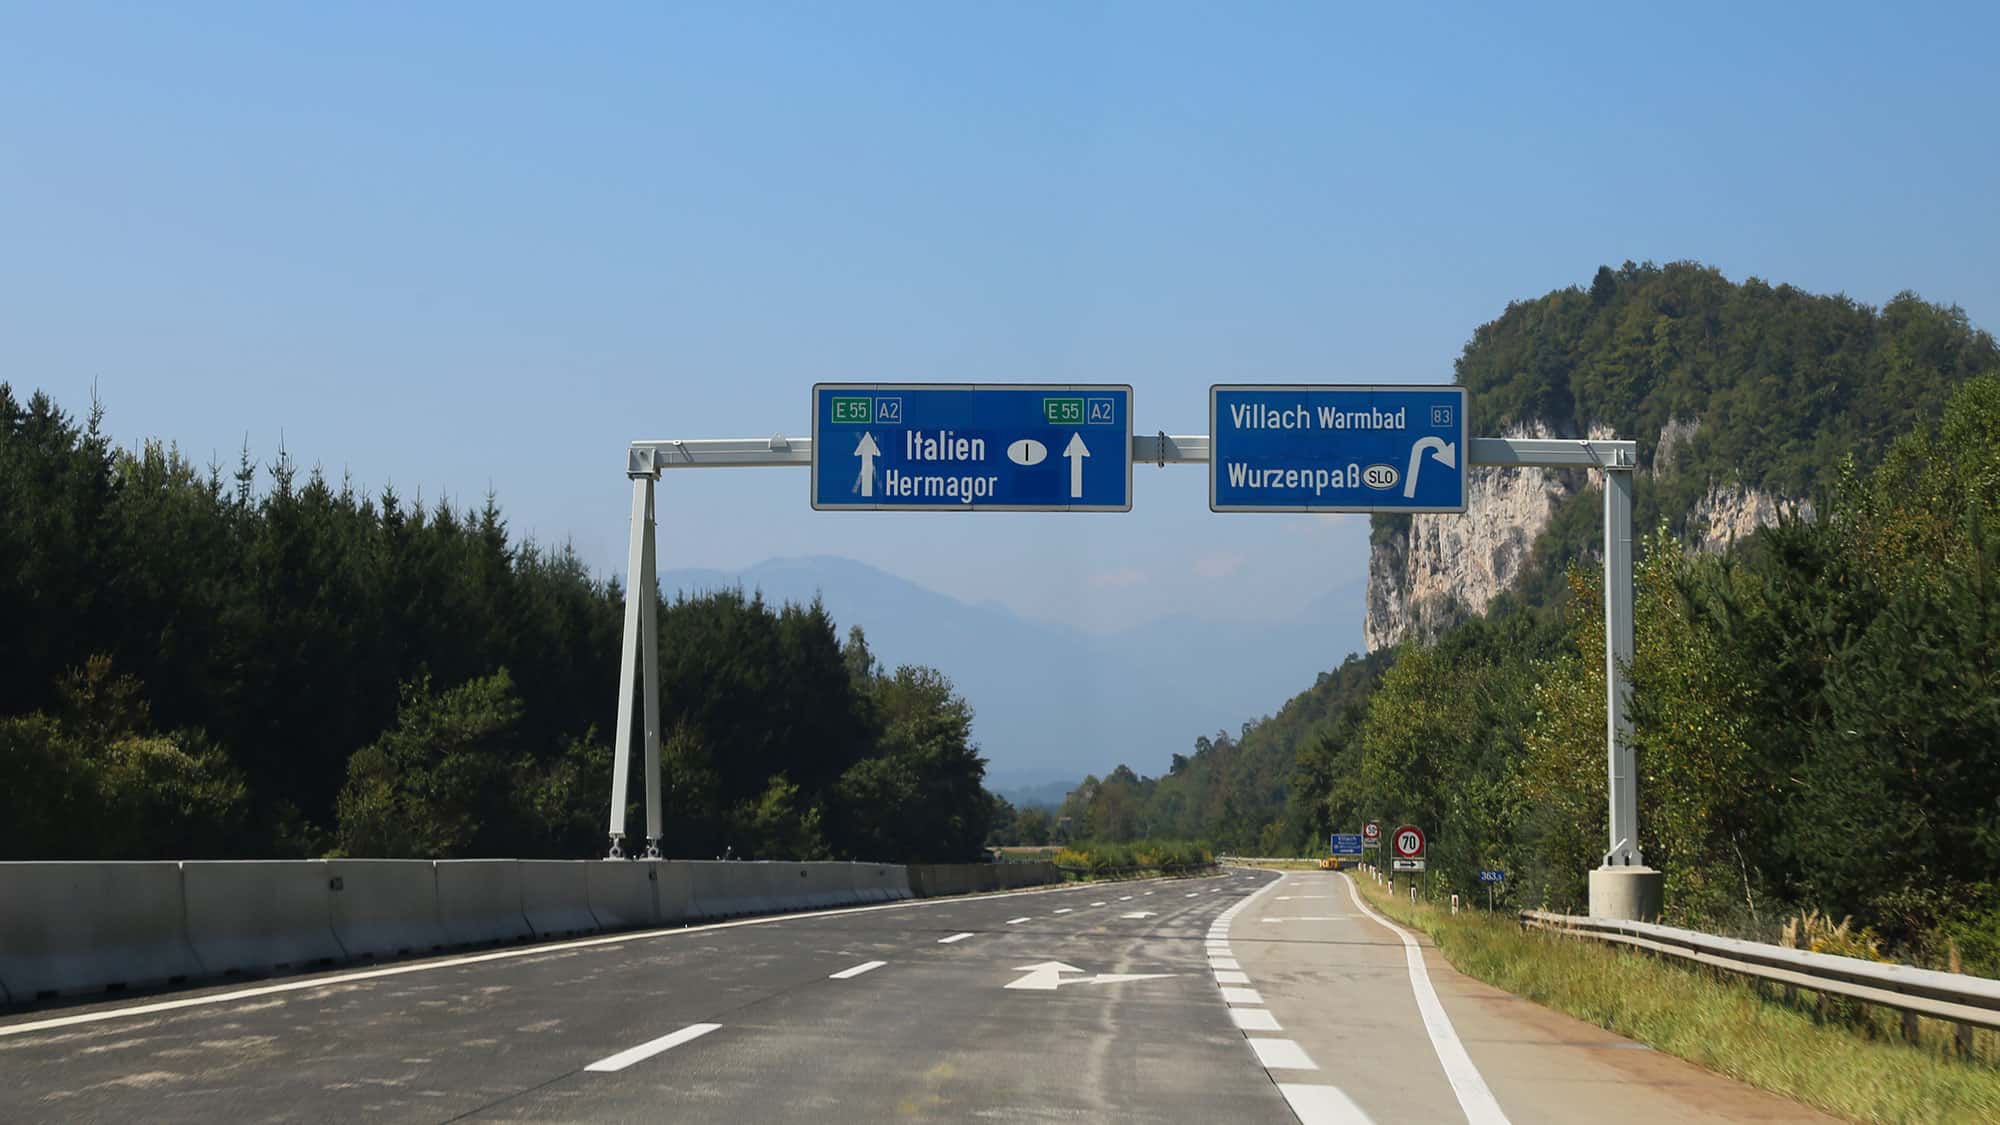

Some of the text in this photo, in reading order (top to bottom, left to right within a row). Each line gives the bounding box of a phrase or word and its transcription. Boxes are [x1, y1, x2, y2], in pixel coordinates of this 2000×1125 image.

[836, 402, 867, 418] E 55
[879, 403, 899, 418] A2
[1048, 403, 1080, 419] E 55
[1091, 403, 1111, 419] A2
[1230, 404, 1405, 429] Villach Warmbad
[1433, 409, 1451, 423] 83
[907, 430, 985, 461] Italien
[1228, 463, 1360, 496] Wurzenpaß
[1368, 470, 1393, 484] SLO
[886, 469, 998, 503] Hermagor
[1402, 835, 1416, 850] 70
